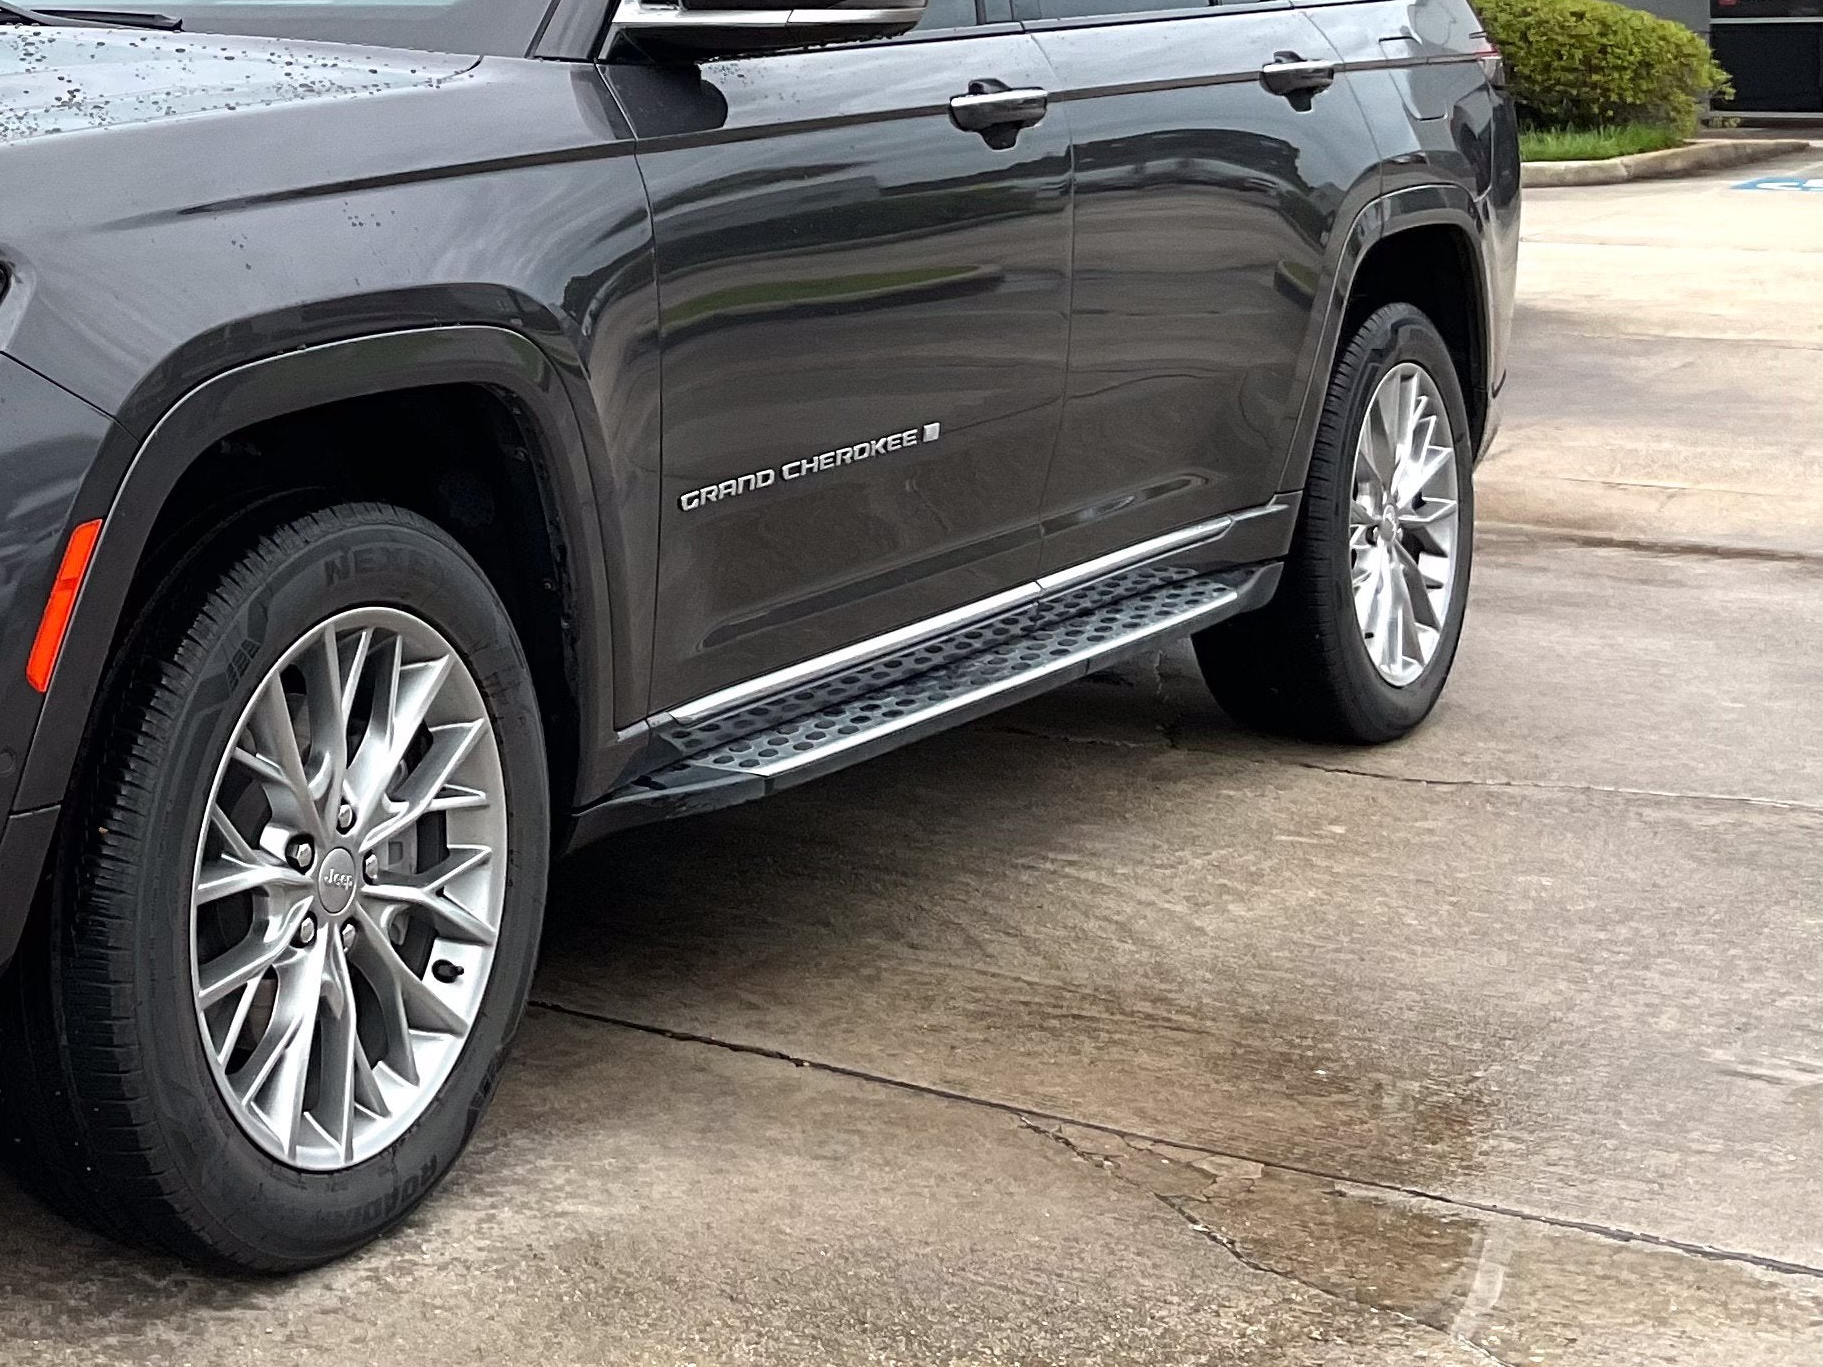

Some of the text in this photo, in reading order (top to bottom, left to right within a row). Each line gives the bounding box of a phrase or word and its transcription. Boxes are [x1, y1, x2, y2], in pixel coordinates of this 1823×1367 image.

[680, 468, 775, 511] GRAND
[781, 428, 919, 481] CHEROKEE
[324, 868, 353, 891] Jeep
